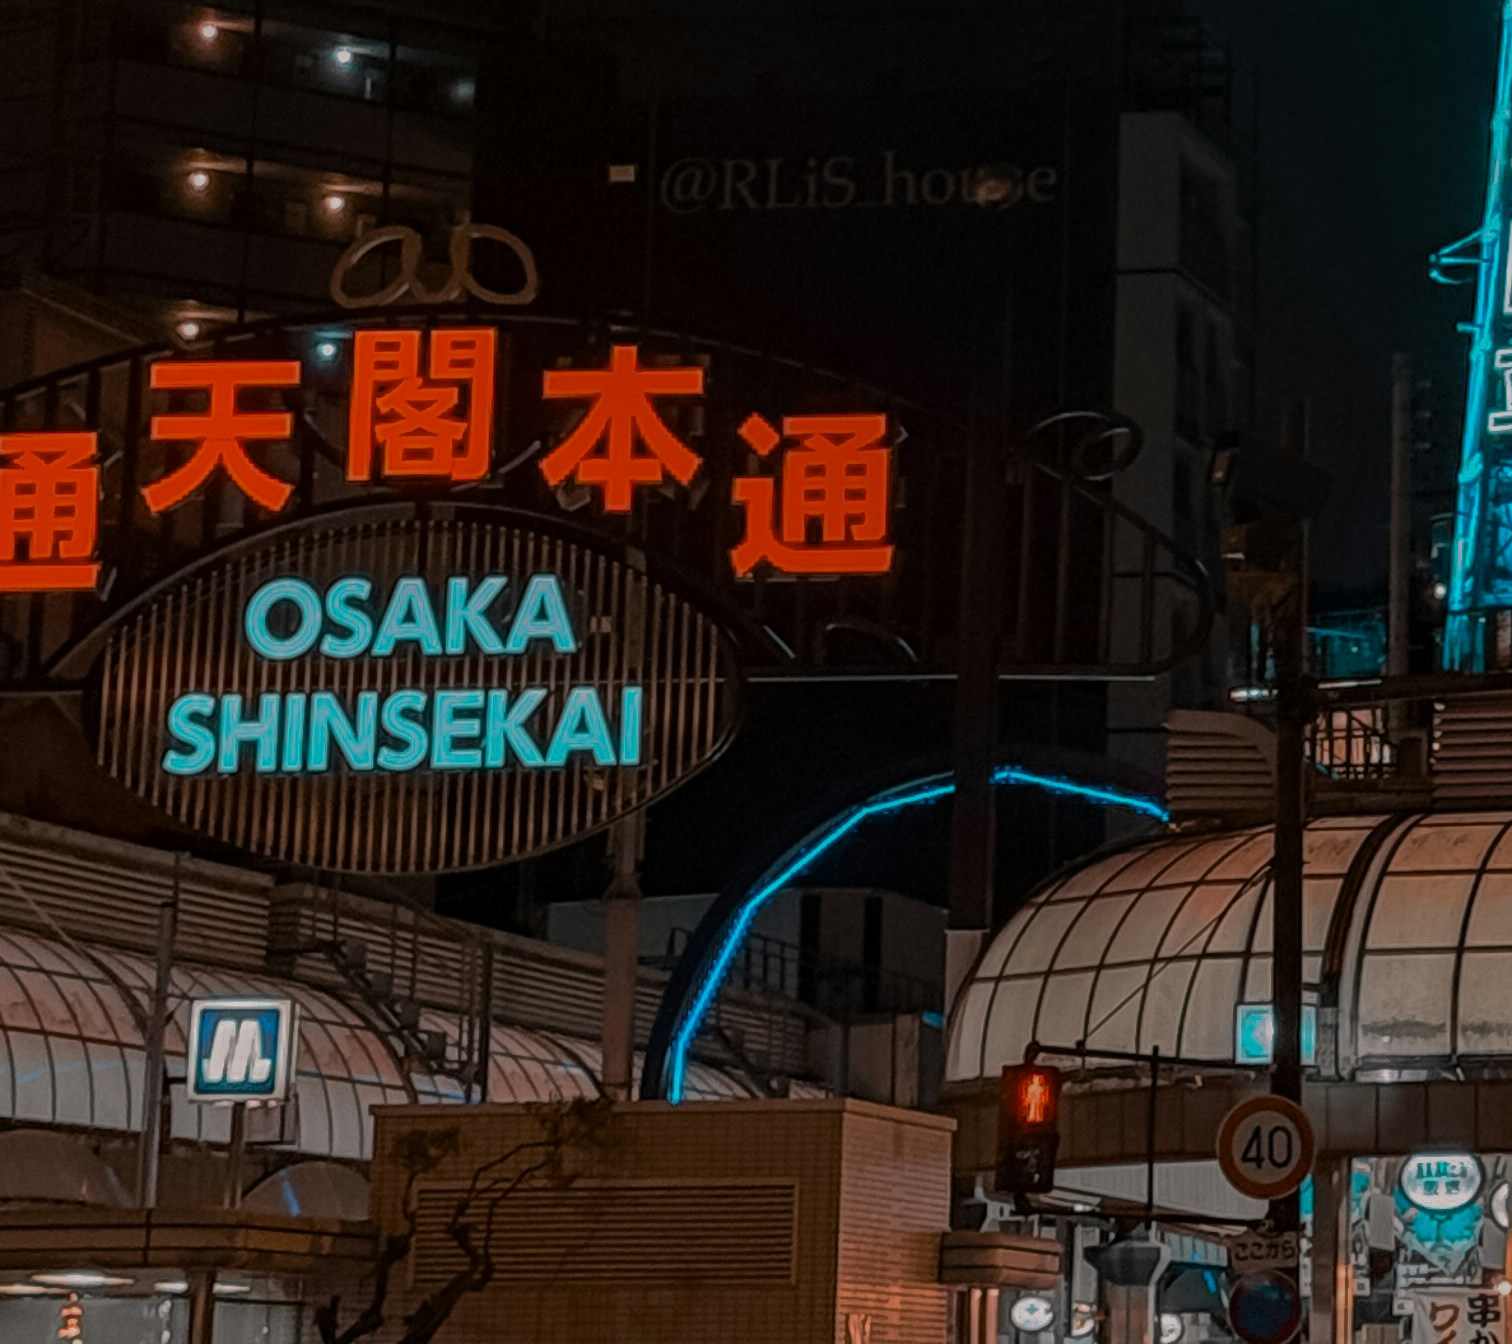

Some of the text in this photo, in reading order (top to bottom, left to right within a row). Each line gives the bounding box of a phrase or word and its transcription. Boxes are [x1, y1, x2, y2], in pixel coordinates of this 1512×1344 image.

[243, 571, 580, 660] OSAKA
[161, 684, 644, 775] SHINSEKAI
[1241, 1125, 1292, 1169] 40
